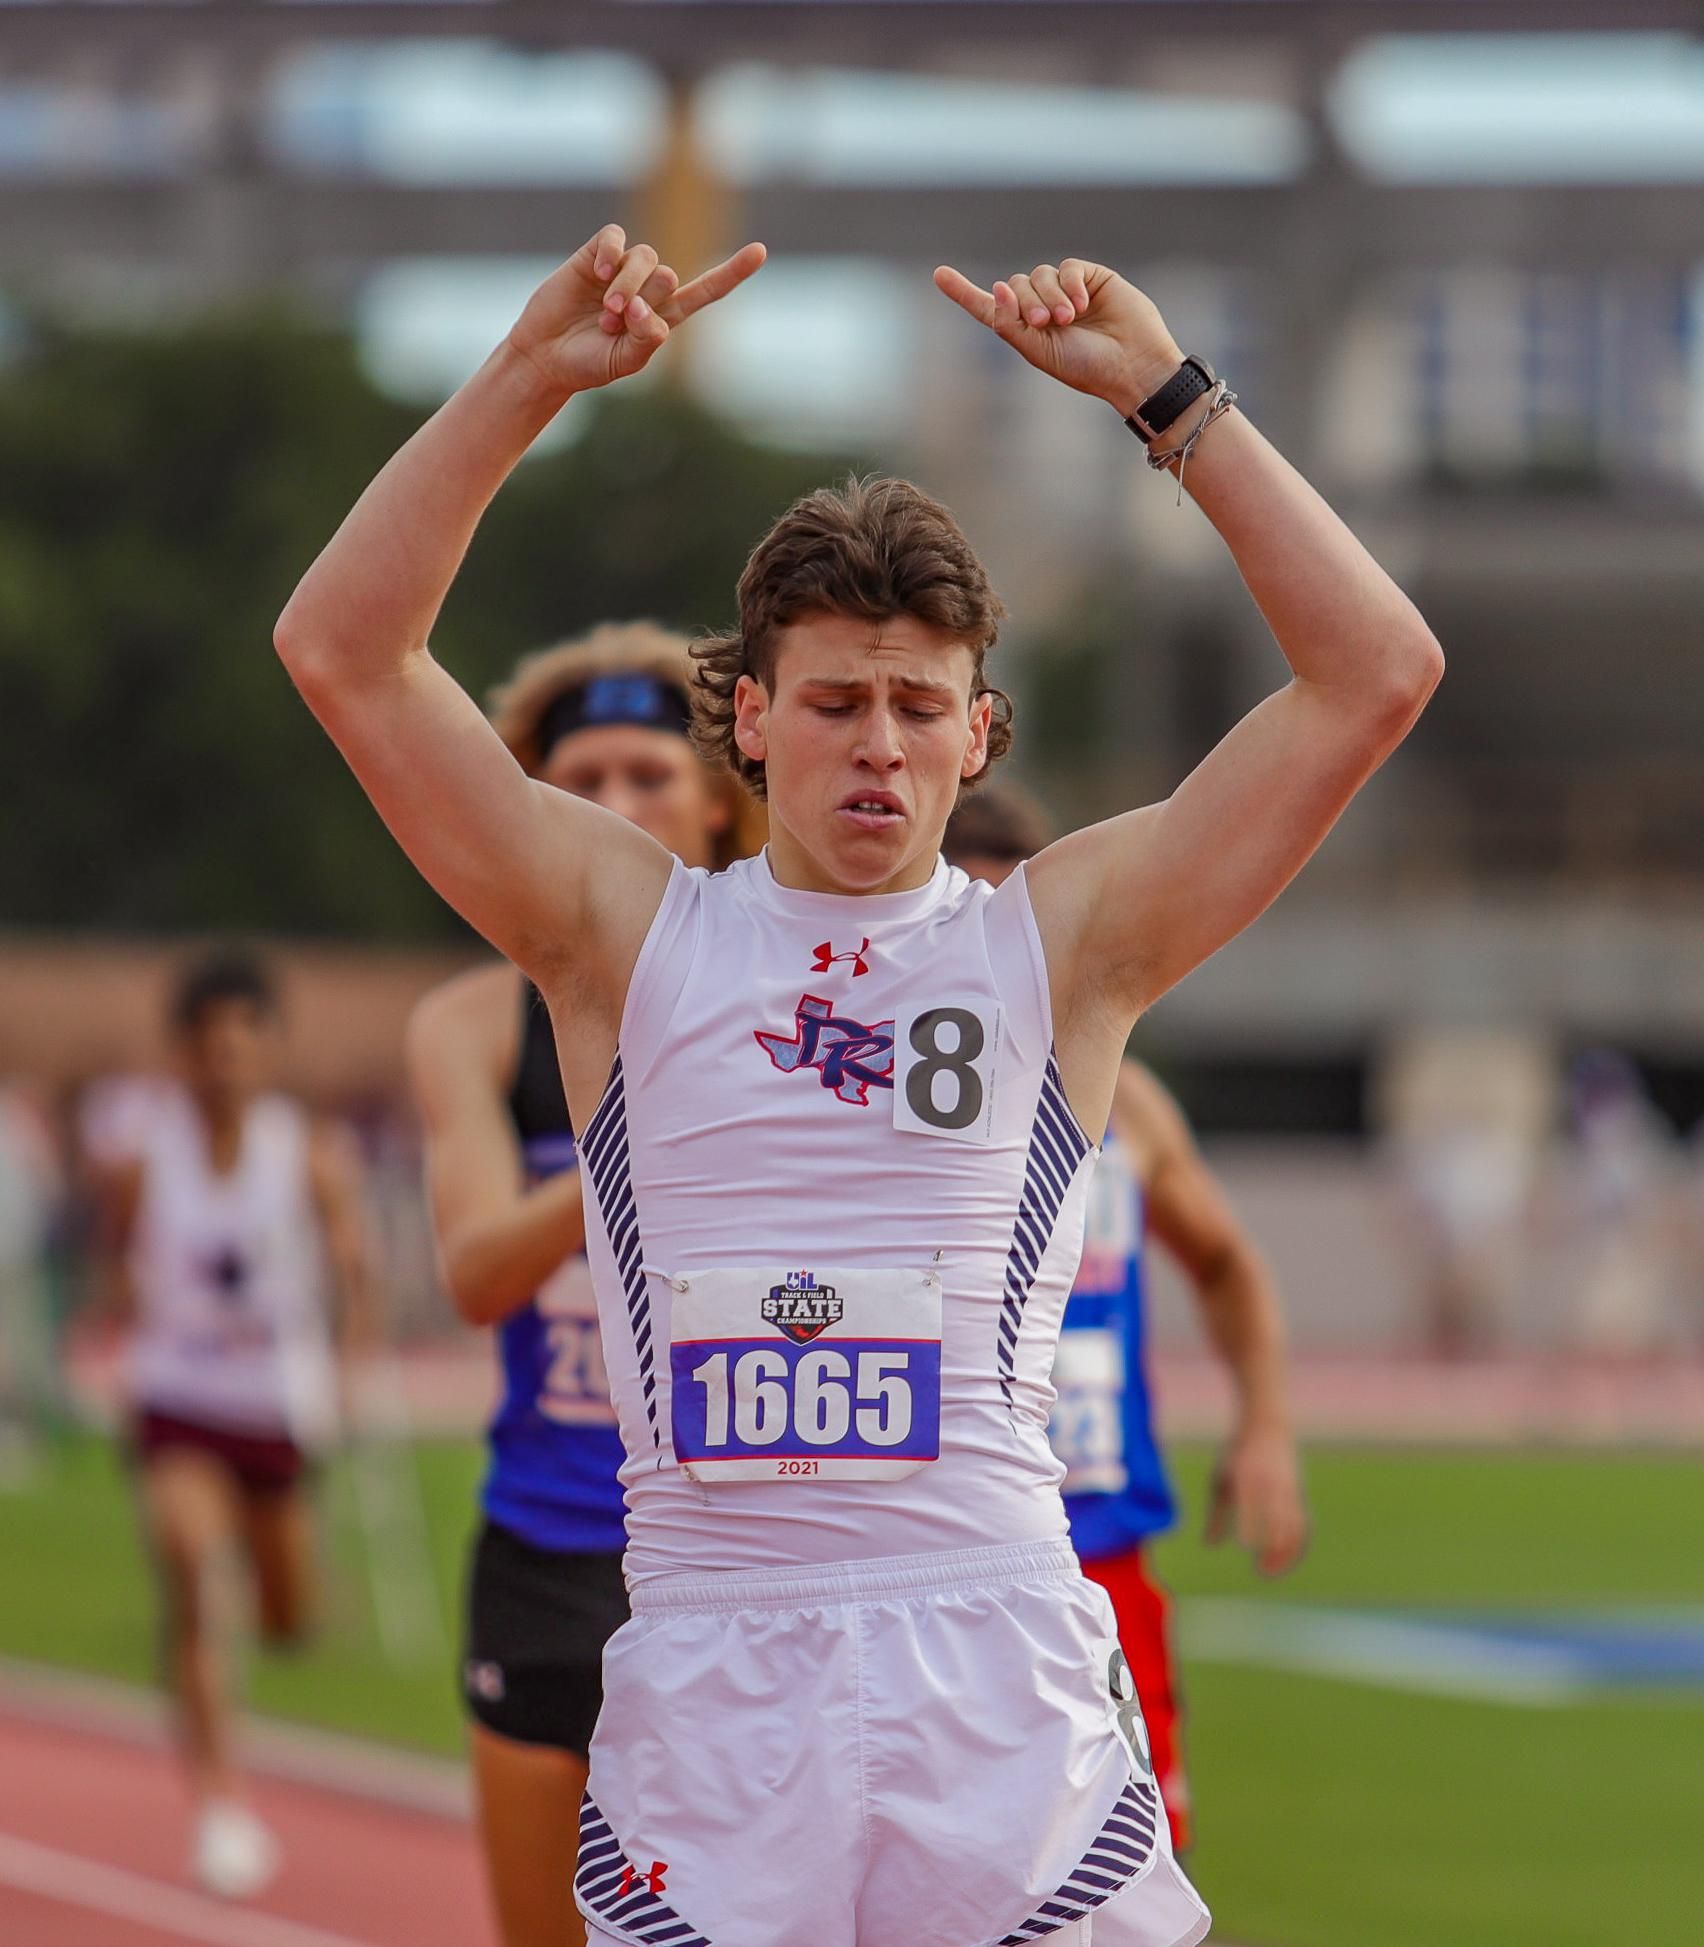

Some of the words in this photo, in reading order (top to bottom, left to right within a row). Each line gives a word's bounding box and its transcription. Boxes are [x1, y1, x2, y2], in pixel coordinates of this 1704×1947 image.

[905, 1007, 984, 1130] 8
[763, 1300, 841, 1317] STATE
[692, 1350, 913, 1447] 1665
[777, 1461, 820, 1475] 2021
